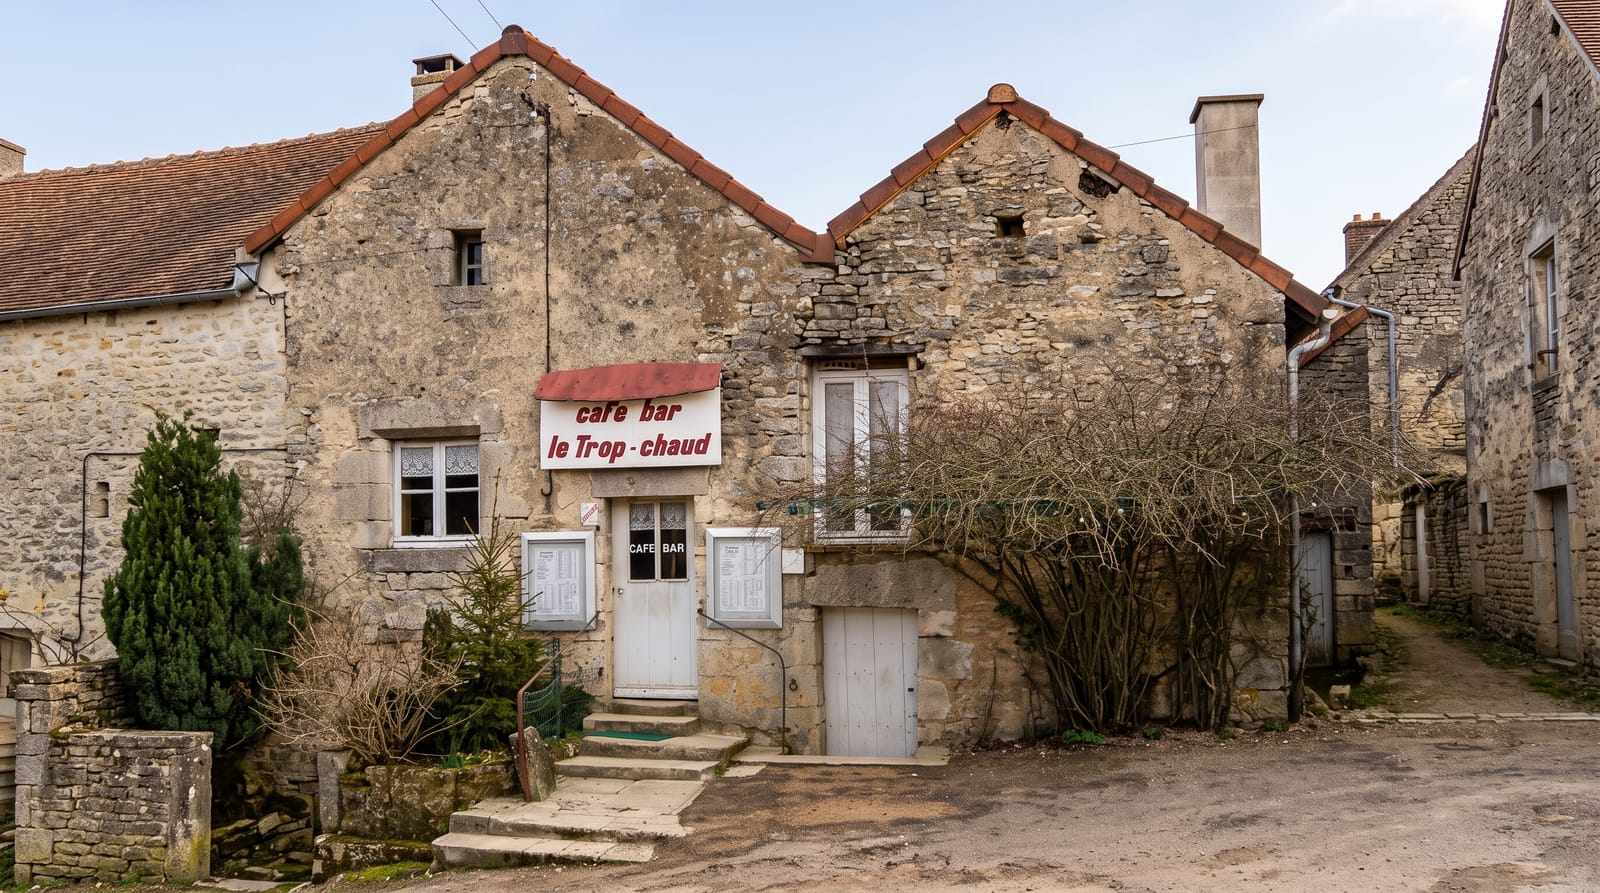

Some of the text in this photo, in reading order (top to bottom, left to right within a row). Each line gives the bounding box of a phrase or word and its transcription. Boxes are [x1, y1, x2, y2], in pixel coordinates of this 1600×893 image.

[639, 399, 683, 422] bar
[547, 435, 570, 459] le
[629, 543, 685, 554] CAFE BAR
